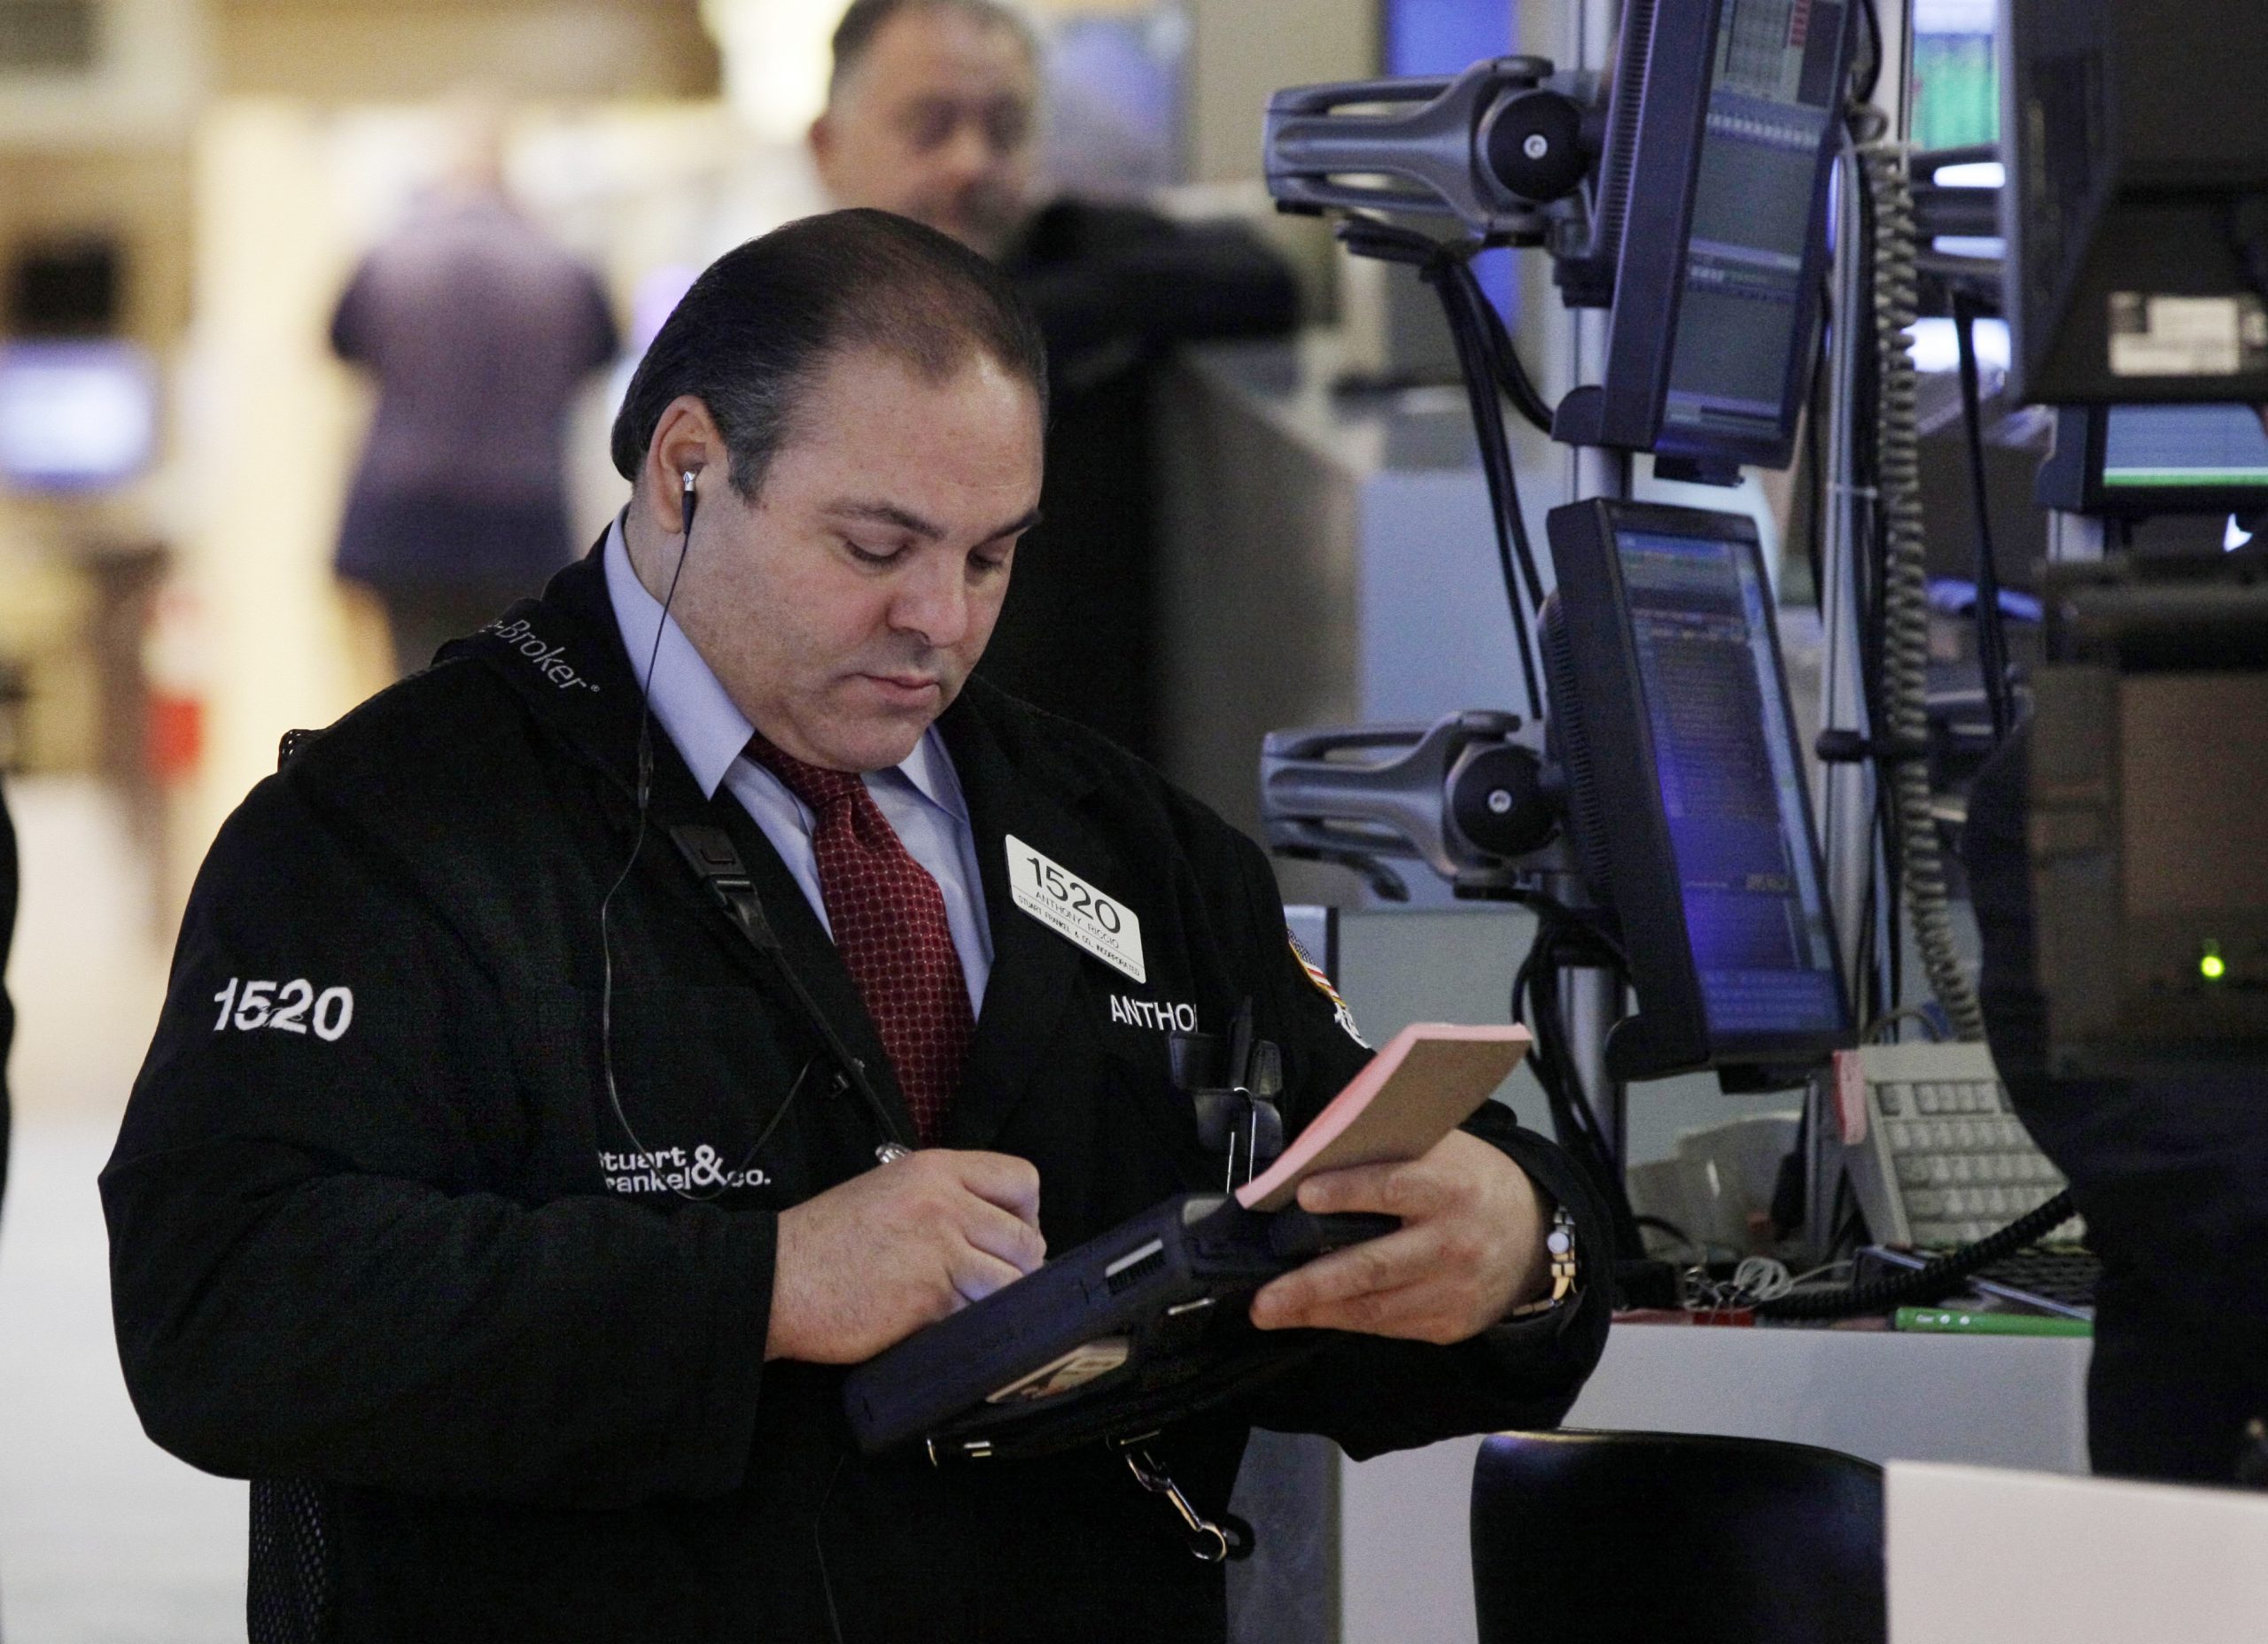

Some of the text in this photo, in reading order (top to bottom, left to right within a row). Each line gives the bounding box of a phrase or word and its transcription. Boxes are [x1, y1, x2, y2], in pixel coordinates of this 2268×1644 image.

[1018, 895, 1042, 915] STUART
[1026, 857, 1122, 934] 1520
[1036, 891, 1120, 949] ANTHONY RICCIO
[214, 977, 353, 1042] 1520
[691, 1144, 727, 1187] &
